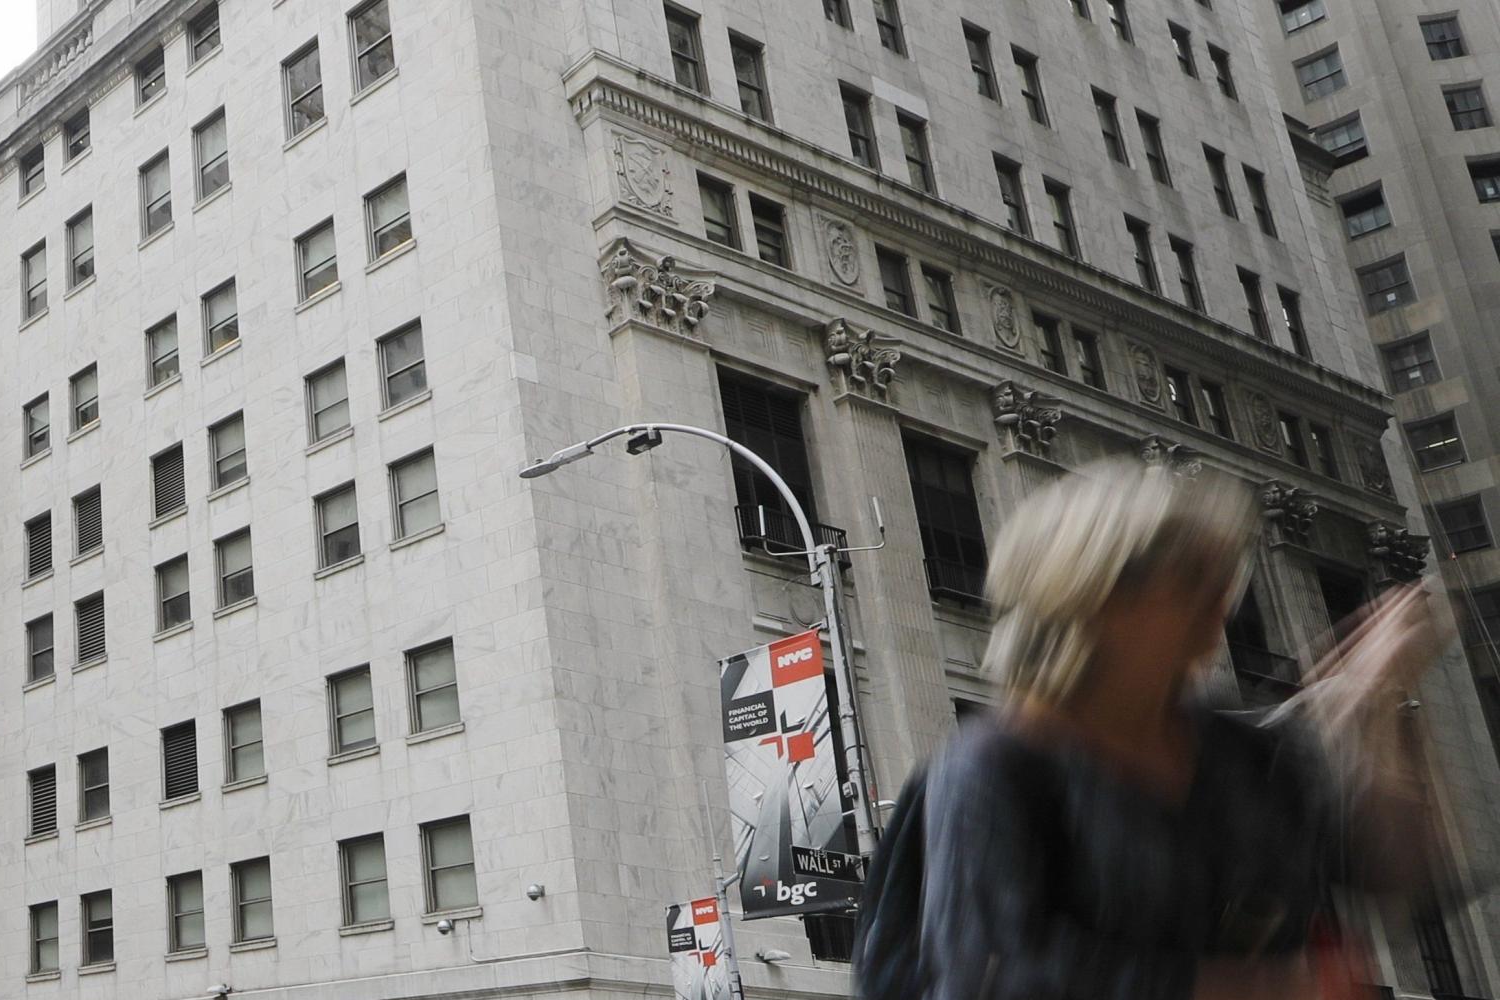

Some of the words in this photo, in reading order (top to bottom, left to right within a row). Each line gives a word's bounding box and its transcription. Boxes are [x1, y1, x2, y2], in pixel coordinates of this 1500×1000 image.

[777, 647, 813, 668] NYC
[728, 702, 767, 716] FINANCIAL
[729, 713, 757, 724] CAPITAL
[758, 709, 768, 717] OF
[729, 724, 743, 732] THE
[743, 717, 769, 729] WORLD
[797, 853, 834, 874] WALL
[833, 859, 841, 868] ST
[777, 880, 817, 905] bgc
